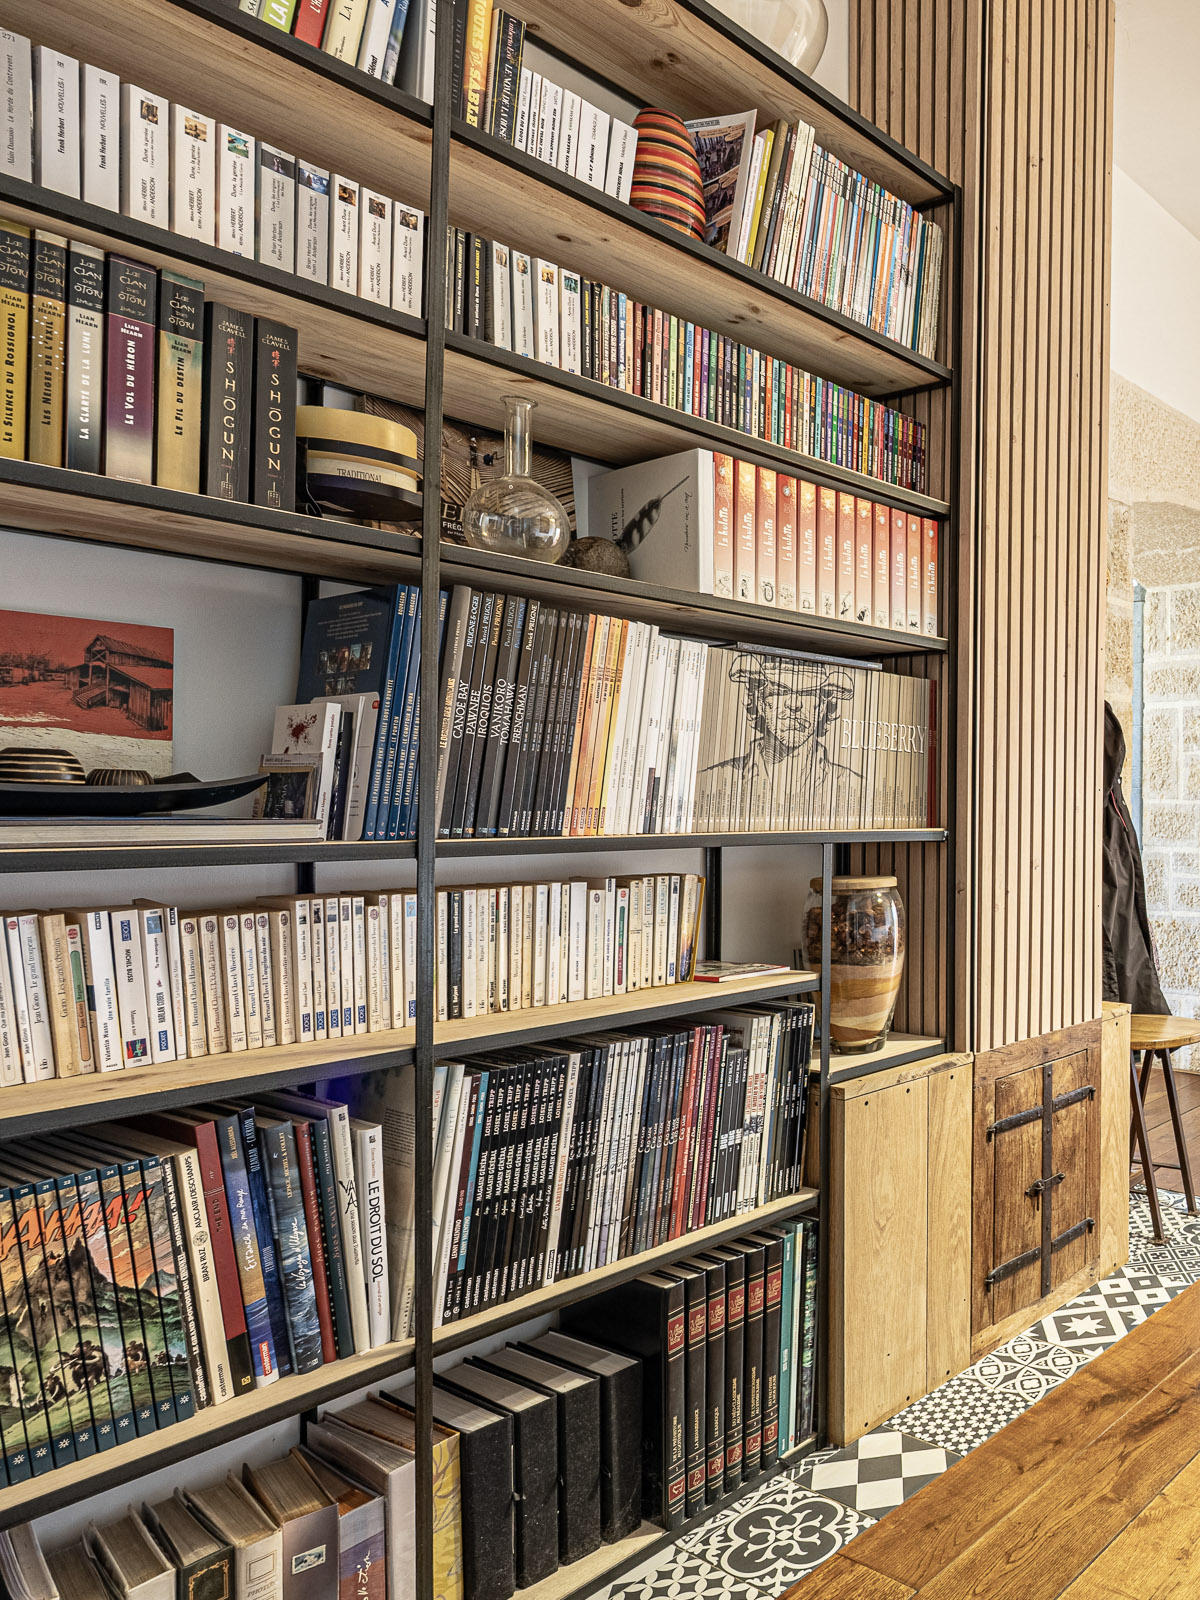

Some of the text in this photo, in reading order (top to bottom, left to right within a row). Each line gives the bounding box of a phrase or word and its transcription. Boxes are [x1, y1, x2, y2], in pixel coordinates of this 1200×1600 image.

[2, 32, 15, 42] 271
[466, 67, 481, 128] SABLE
[121, 328, 143, 338] HEARN
[124, 323, 140, 331] LIAN
[218, 324, 247, 339] CLAVELL
[221, 320, 244, 332] JAMES
[265, 334, 289, 345] JAMES
[82, 331, 92, 354] LUNE
[261, 338, 291, 351] CLAVELL
[82, 374, 90, 386] DE
[127, 376, 135, 388] DU
[177, 357, 185, 387] DESTIN
[177, 391, 184, 403] DU
[718, 507, 728, 536] hulotte
[742, 512, 752, 540] hulotte
[763, 519, 773, 546] hulotte
[782, 524, 792, 551] hulotte
[803, 528, 812, 556] hulotte
[467, 619, 476, 648] PRUGNE
[480, 597, 492, 644] Patrick PRUGNE
[526, 604, 538, 650] Patrick PRUGNE
[453, 680, 469, 739] CANOE BAY
[466, 690, 480, 735] PAWNEE
[478, 684, 493, 738] IROQUOIS
[491, 678, 506, 738] VANIKORO
[500, 682, 516, 745] TOMAHAWK
[512, 685, 527, 743] FRENCHMAN
[840, 718, 928, 754] BLUEBERRY
[159, 1030, 168, 1051] POCKET
[488, 1089, 496, 1108] TRIPP
[367, 1180, 380, 1198] LE
[368, 1199, 382, 1236] DROIT
[199, 1247, 207, 1262] RUZ
[371, 1237, 382, 1256] DU
[200, 1263, 210, 1283] BRAN
[372, 1257, 384, 1283] SOL
[262, 1343, 271, 1375] casterman
[218, 1363, 226, 1397] casterman
